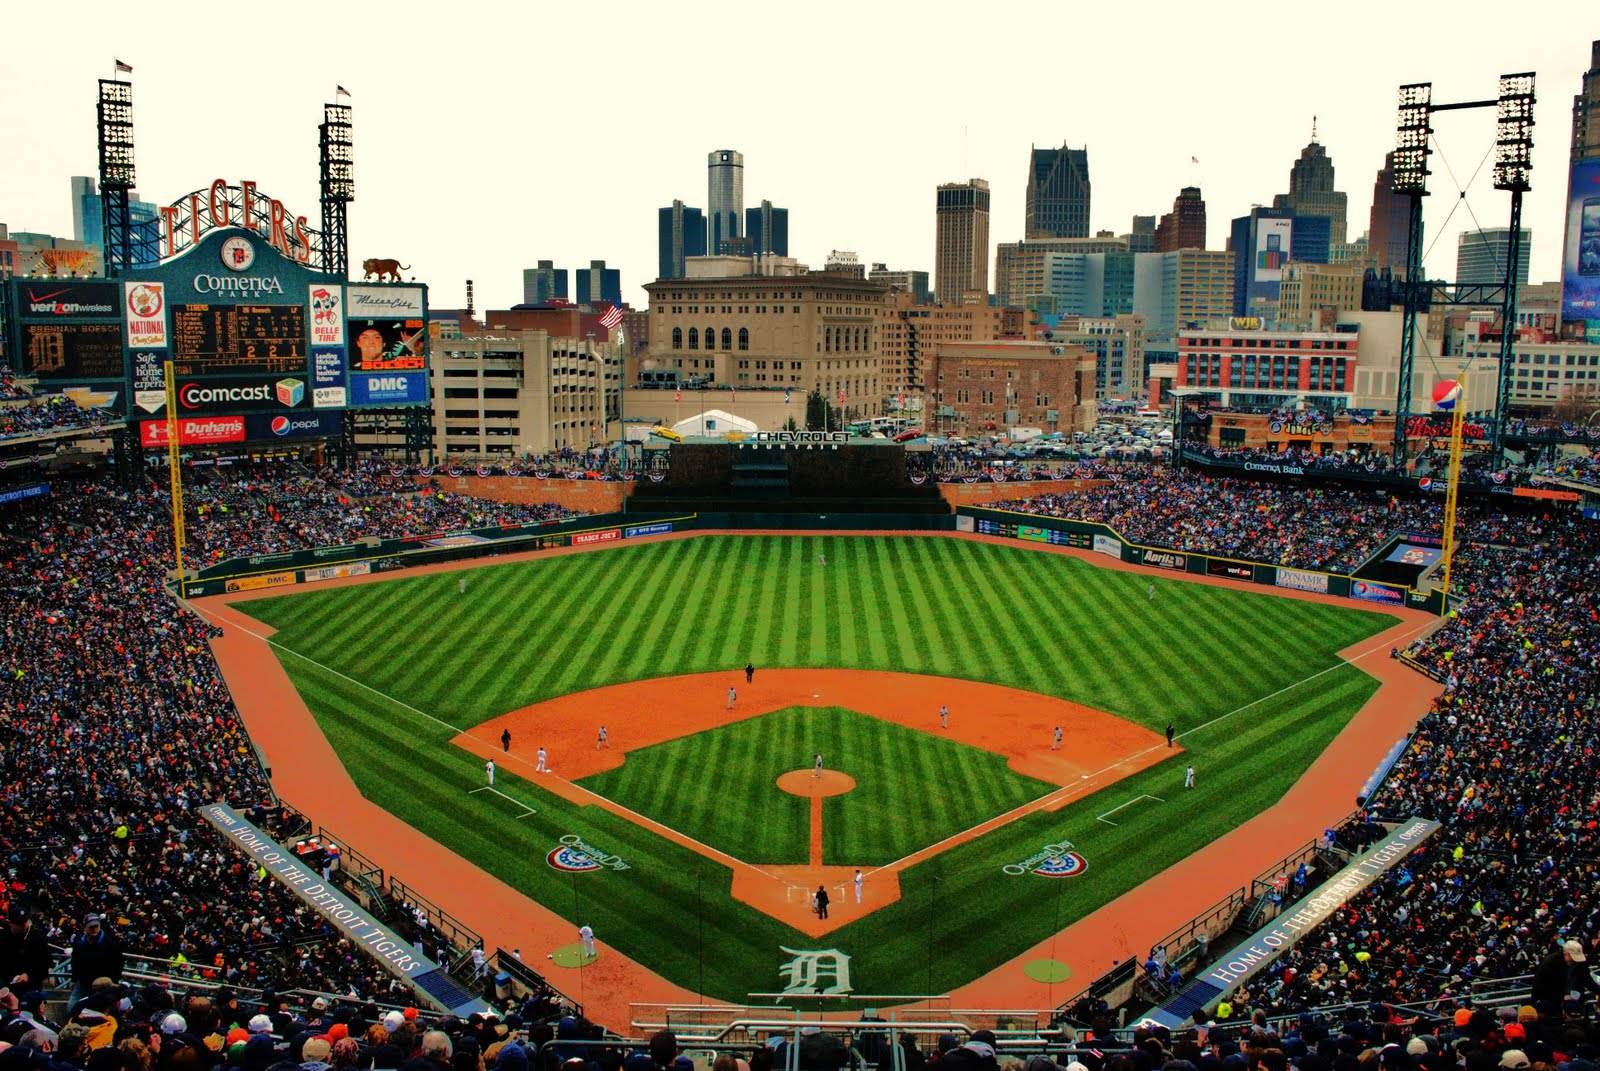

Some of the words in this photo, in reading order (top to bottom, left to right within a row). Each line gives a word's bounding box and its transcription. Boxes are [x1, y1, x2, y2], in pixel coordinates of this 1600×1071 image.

[159, 178, 310, 263] TIGERS
[130, 320, 164, 335] NATIONAL
[314, 326, 340, 334] BELLE
[318, 334, 337, 342] TIRE
[247, 345, 256, 358] 2
[269, 345, 277, 358] 2
[291, 344, 298, 358] 1
[136, 352, 157, 365] Safe
[135, 366, 164, 377] home
[368, 377, 408, 392] DMC
[186, 384, 271, 404] comcast
[185, 420, 242, 435] Dunham's
[291, 418, 320, 431] pepsi
[756, 430, 852, 442] CHEVROLET
[1282, 465, 1305, 475] Bank
[230, 826, 271, 853] HOME
[263, 852, 287, 865] OF
[280, 864, 311, 885] THE
[303, 883, 369, 931] DETROIT
[362, 928, 421, 974] TIGERS
[1211, 944, 1270, 984] HOME
[1263, 929, 1290, 948] OF
[1282, 905, 1319, 937] THE
[1309, 868, 1369, 909] DETROIT
[1360, 841, 1407, 870] TIGERS
